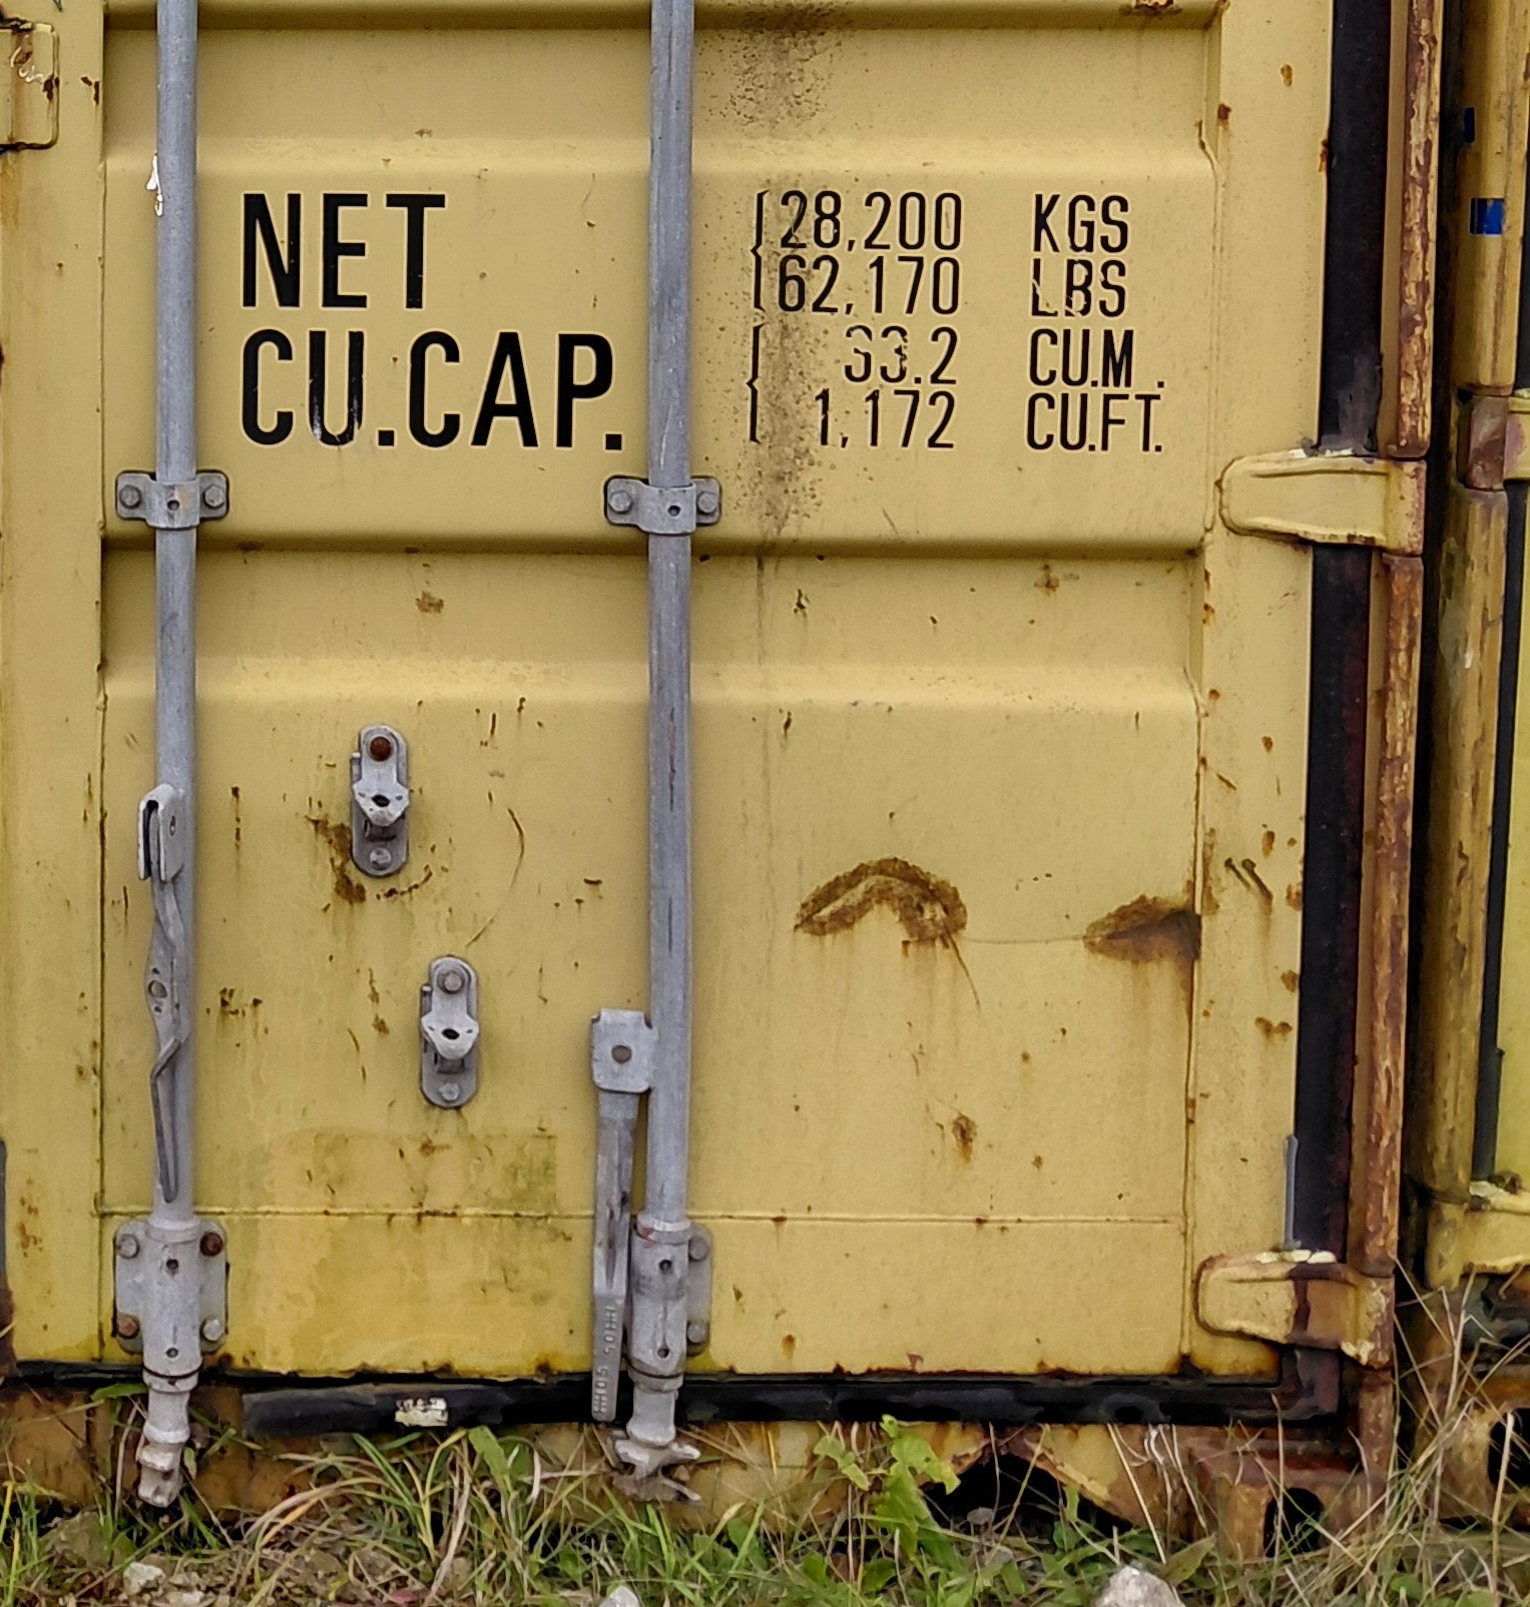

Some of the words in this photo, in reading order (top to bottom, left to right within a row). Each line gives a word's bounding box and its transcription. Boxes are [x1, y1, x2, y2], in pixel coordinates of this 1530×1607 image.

[244, 194, 445, 308] NET
[781, 191, 961, 251] 28,200
[1034, 194, 1128, 252] KGS
[779, 255, 959, 314] 62,170
[1032, 259, 1125, 317] LBS
[845, 325, 957, 384] 33.2
[243, 329, 621, 450] CU.CAP.
[816, 389, 954, 448] 1,172
